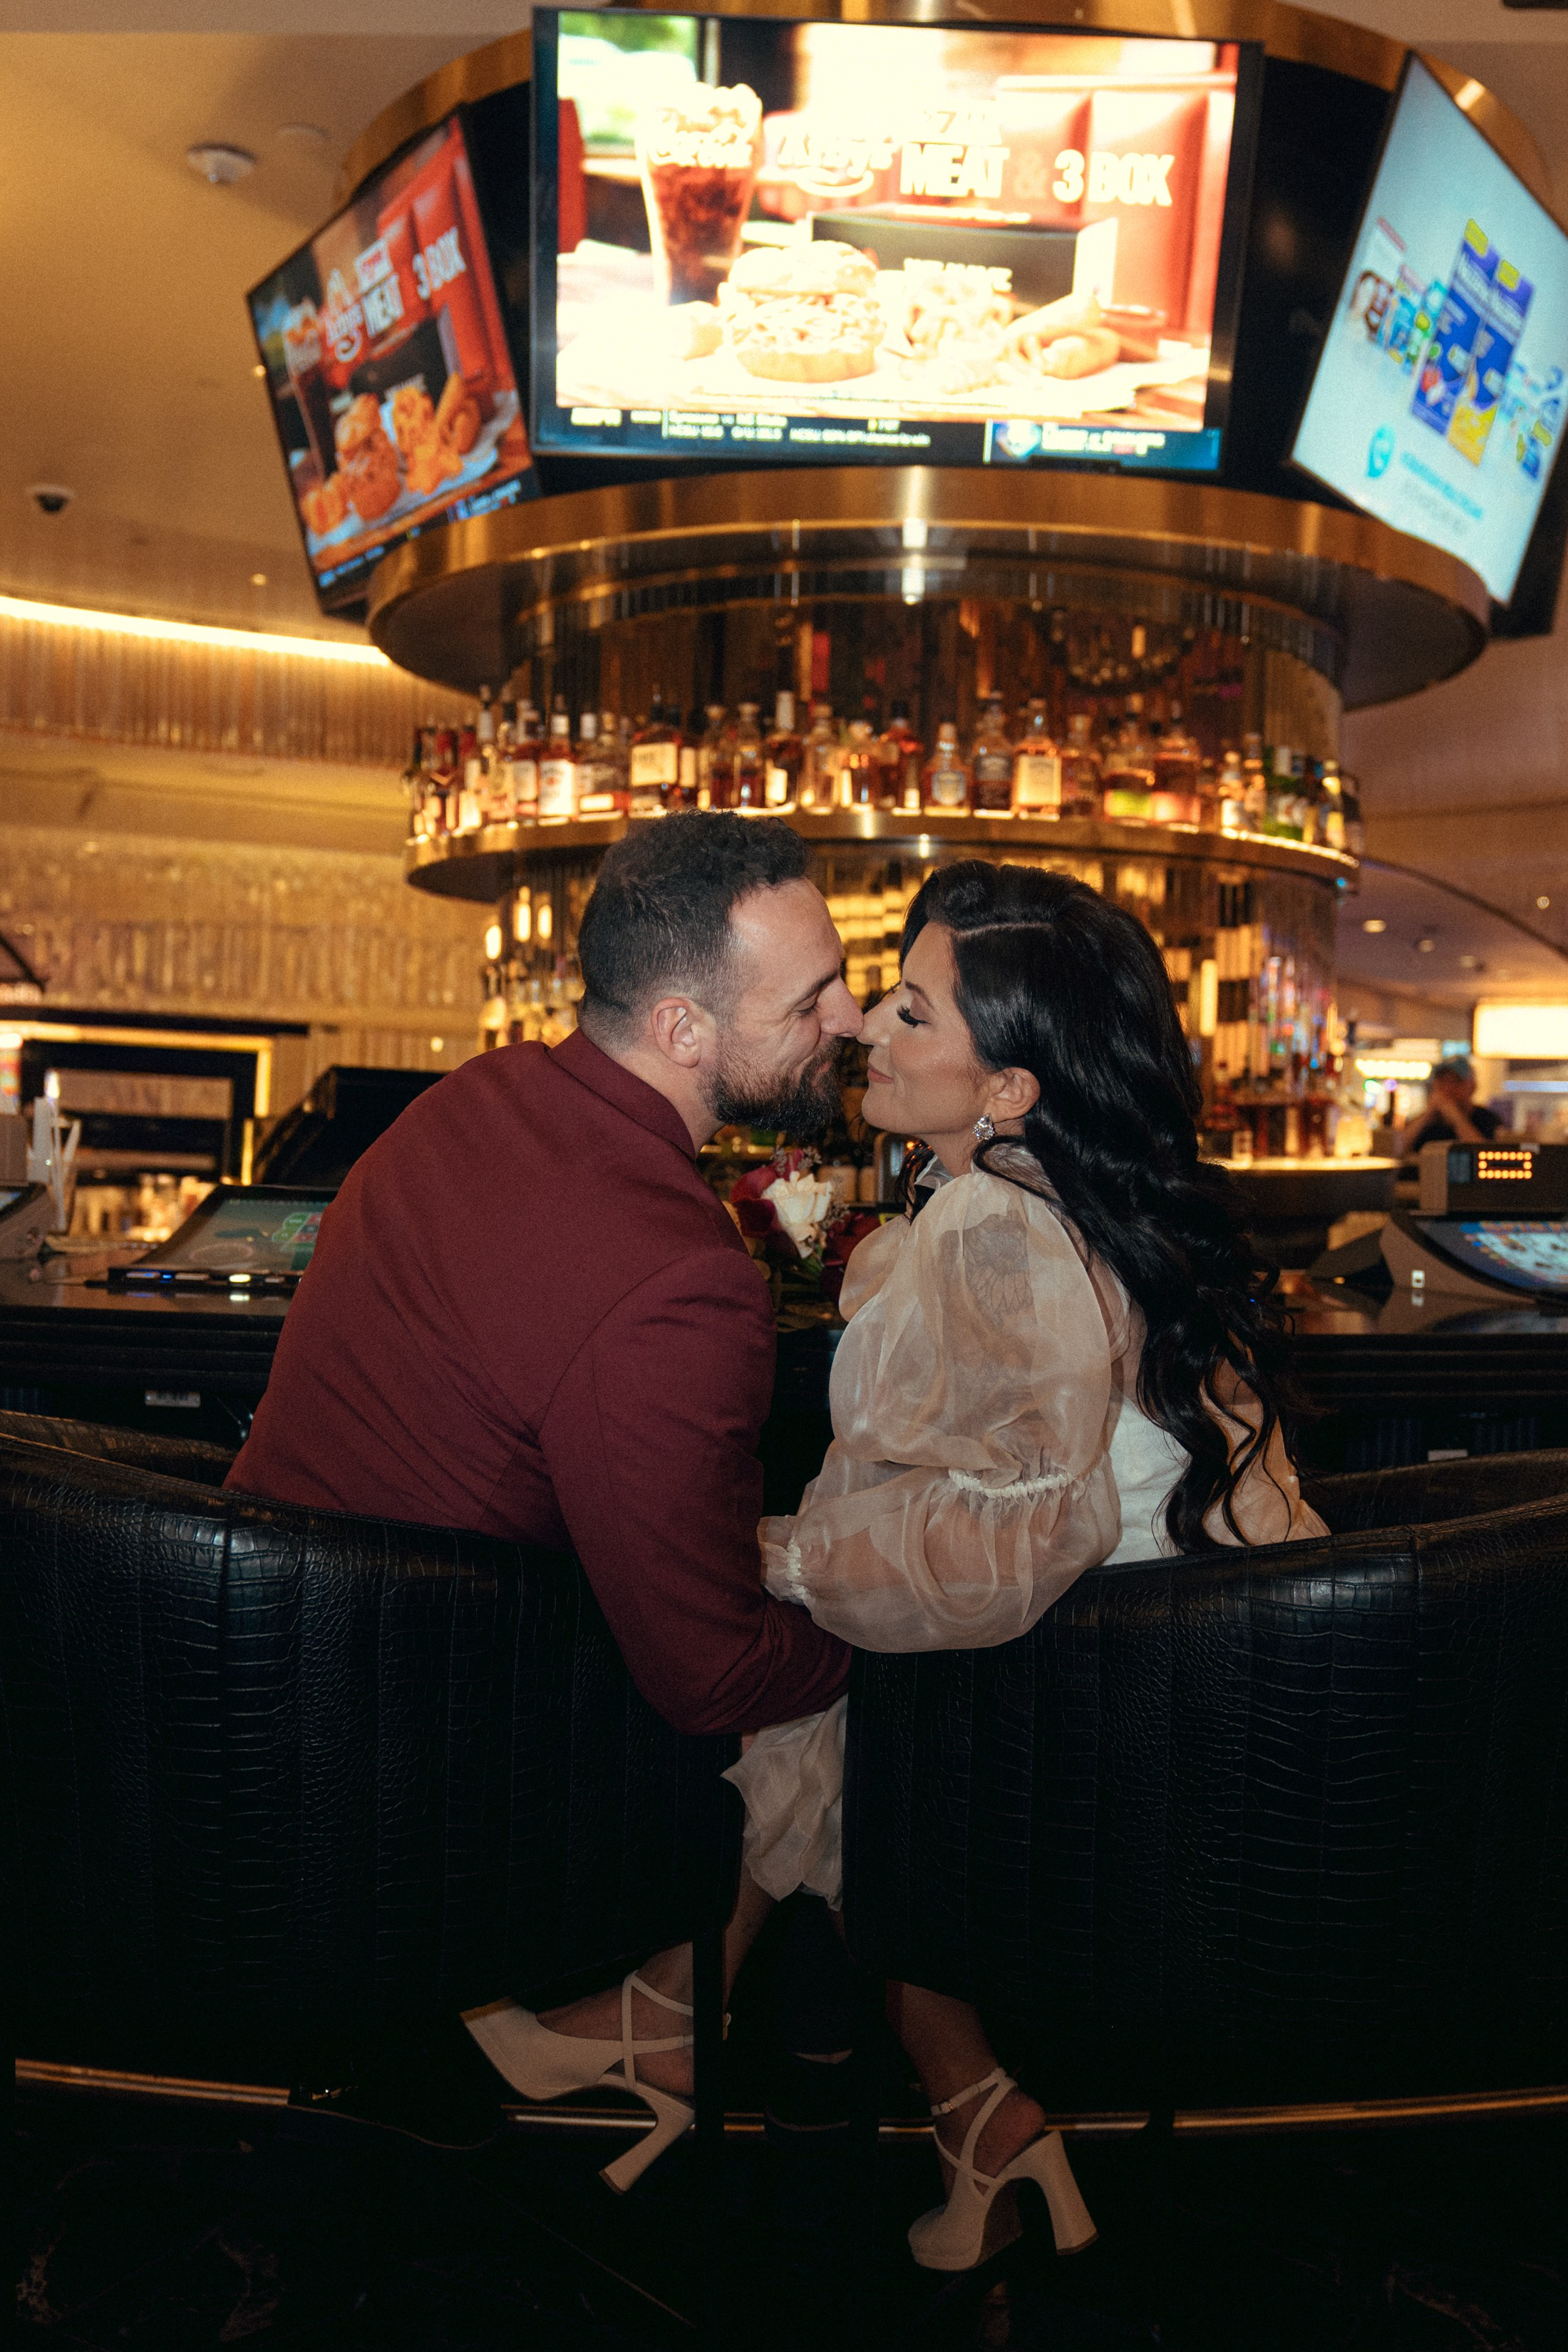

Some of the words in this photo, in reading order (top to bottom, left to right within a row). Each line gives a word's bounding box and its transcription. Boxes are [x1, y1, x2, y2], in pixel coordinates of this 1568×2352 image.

[900, 143, 1011, 197] MEAT
[1013, 151, 1048, 200] &
[1053, 148, 1085, 204] 3
[1088, 151, 1176, 207] BOX
[424, 225, 467, 292] BOX
